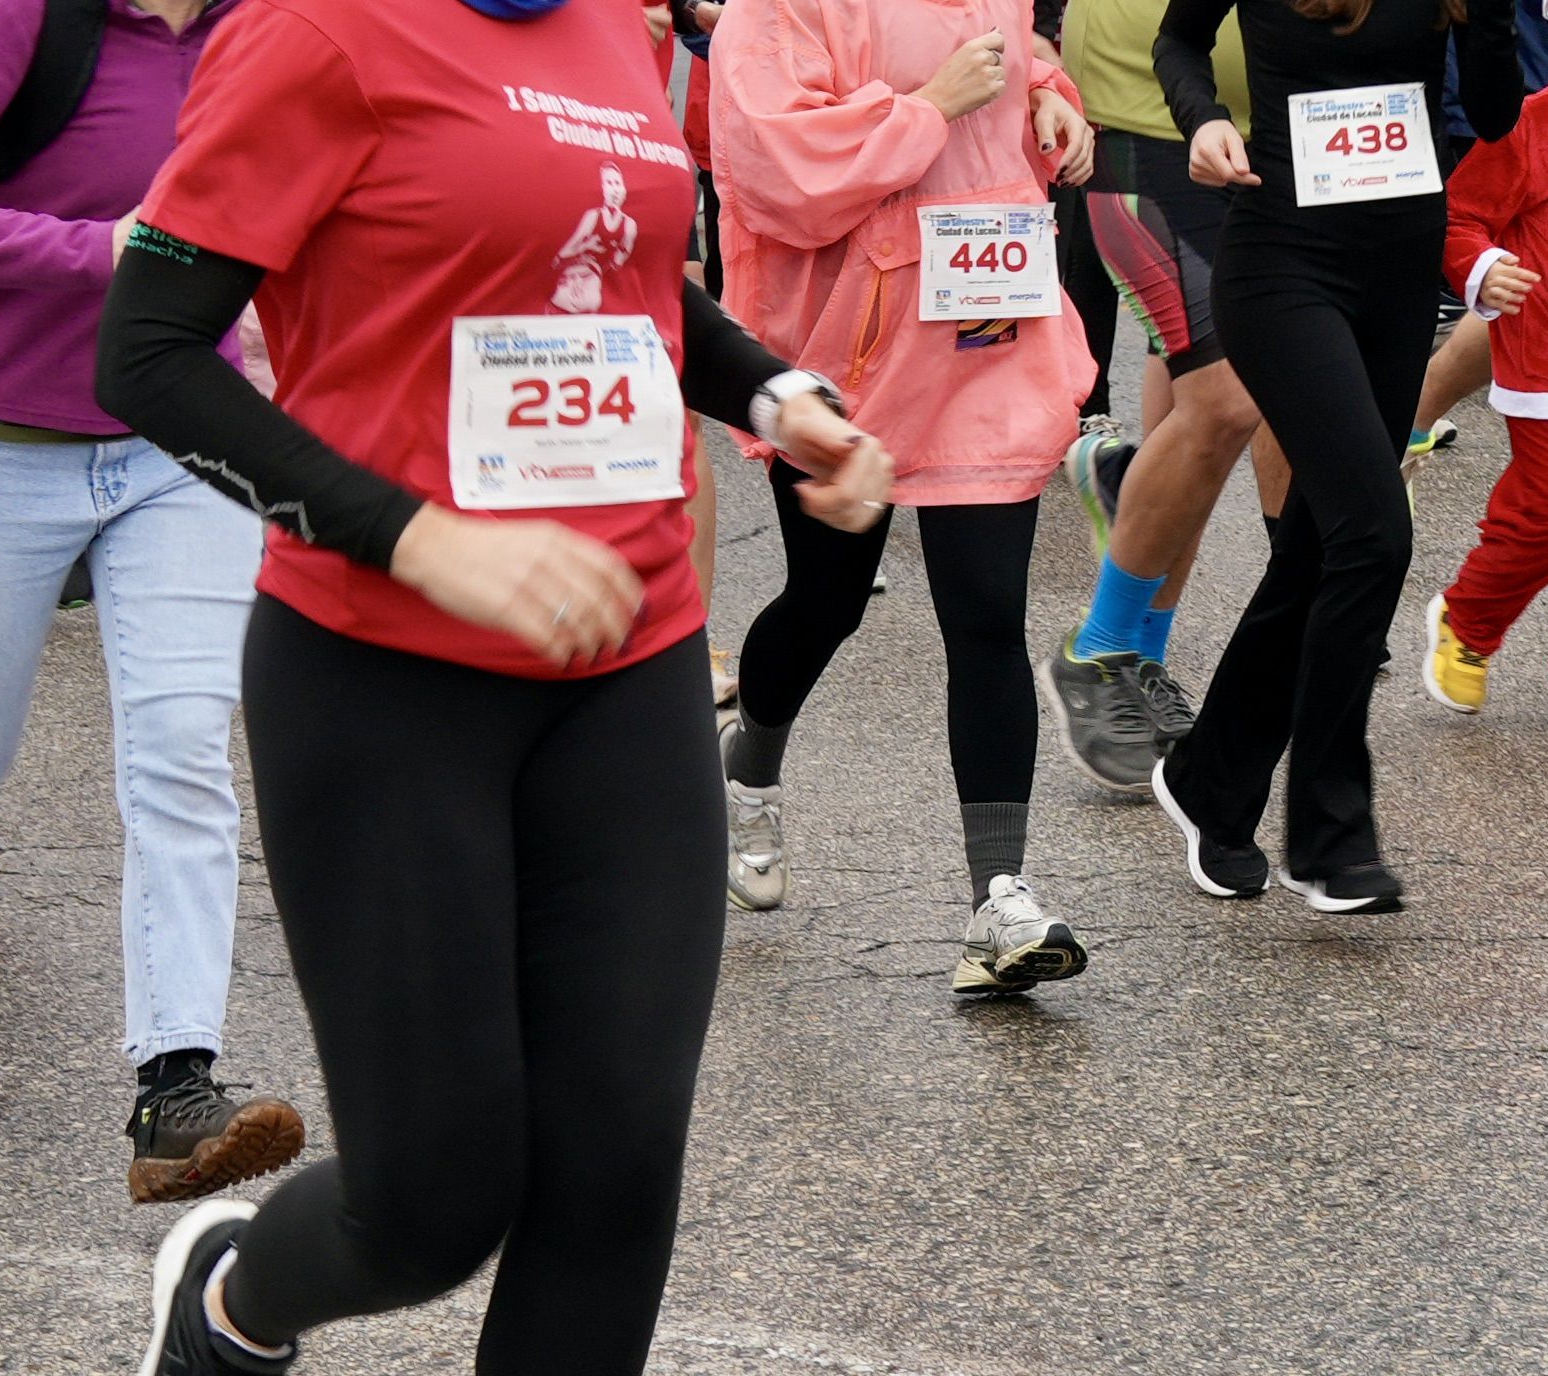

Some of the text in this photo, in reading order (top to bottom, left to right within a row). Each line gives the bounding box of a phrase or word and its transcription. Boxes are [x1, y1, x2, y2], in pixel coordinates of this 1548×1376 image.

[502, 85, 522, 111] I
[519, 86, 565, 115] San
[547, 115, 614, 154] Ciudad
[1325, 122, 1407, 156] 438
[949, 241, 1027, 273] 440
[507, 375, 636, 429] 234
